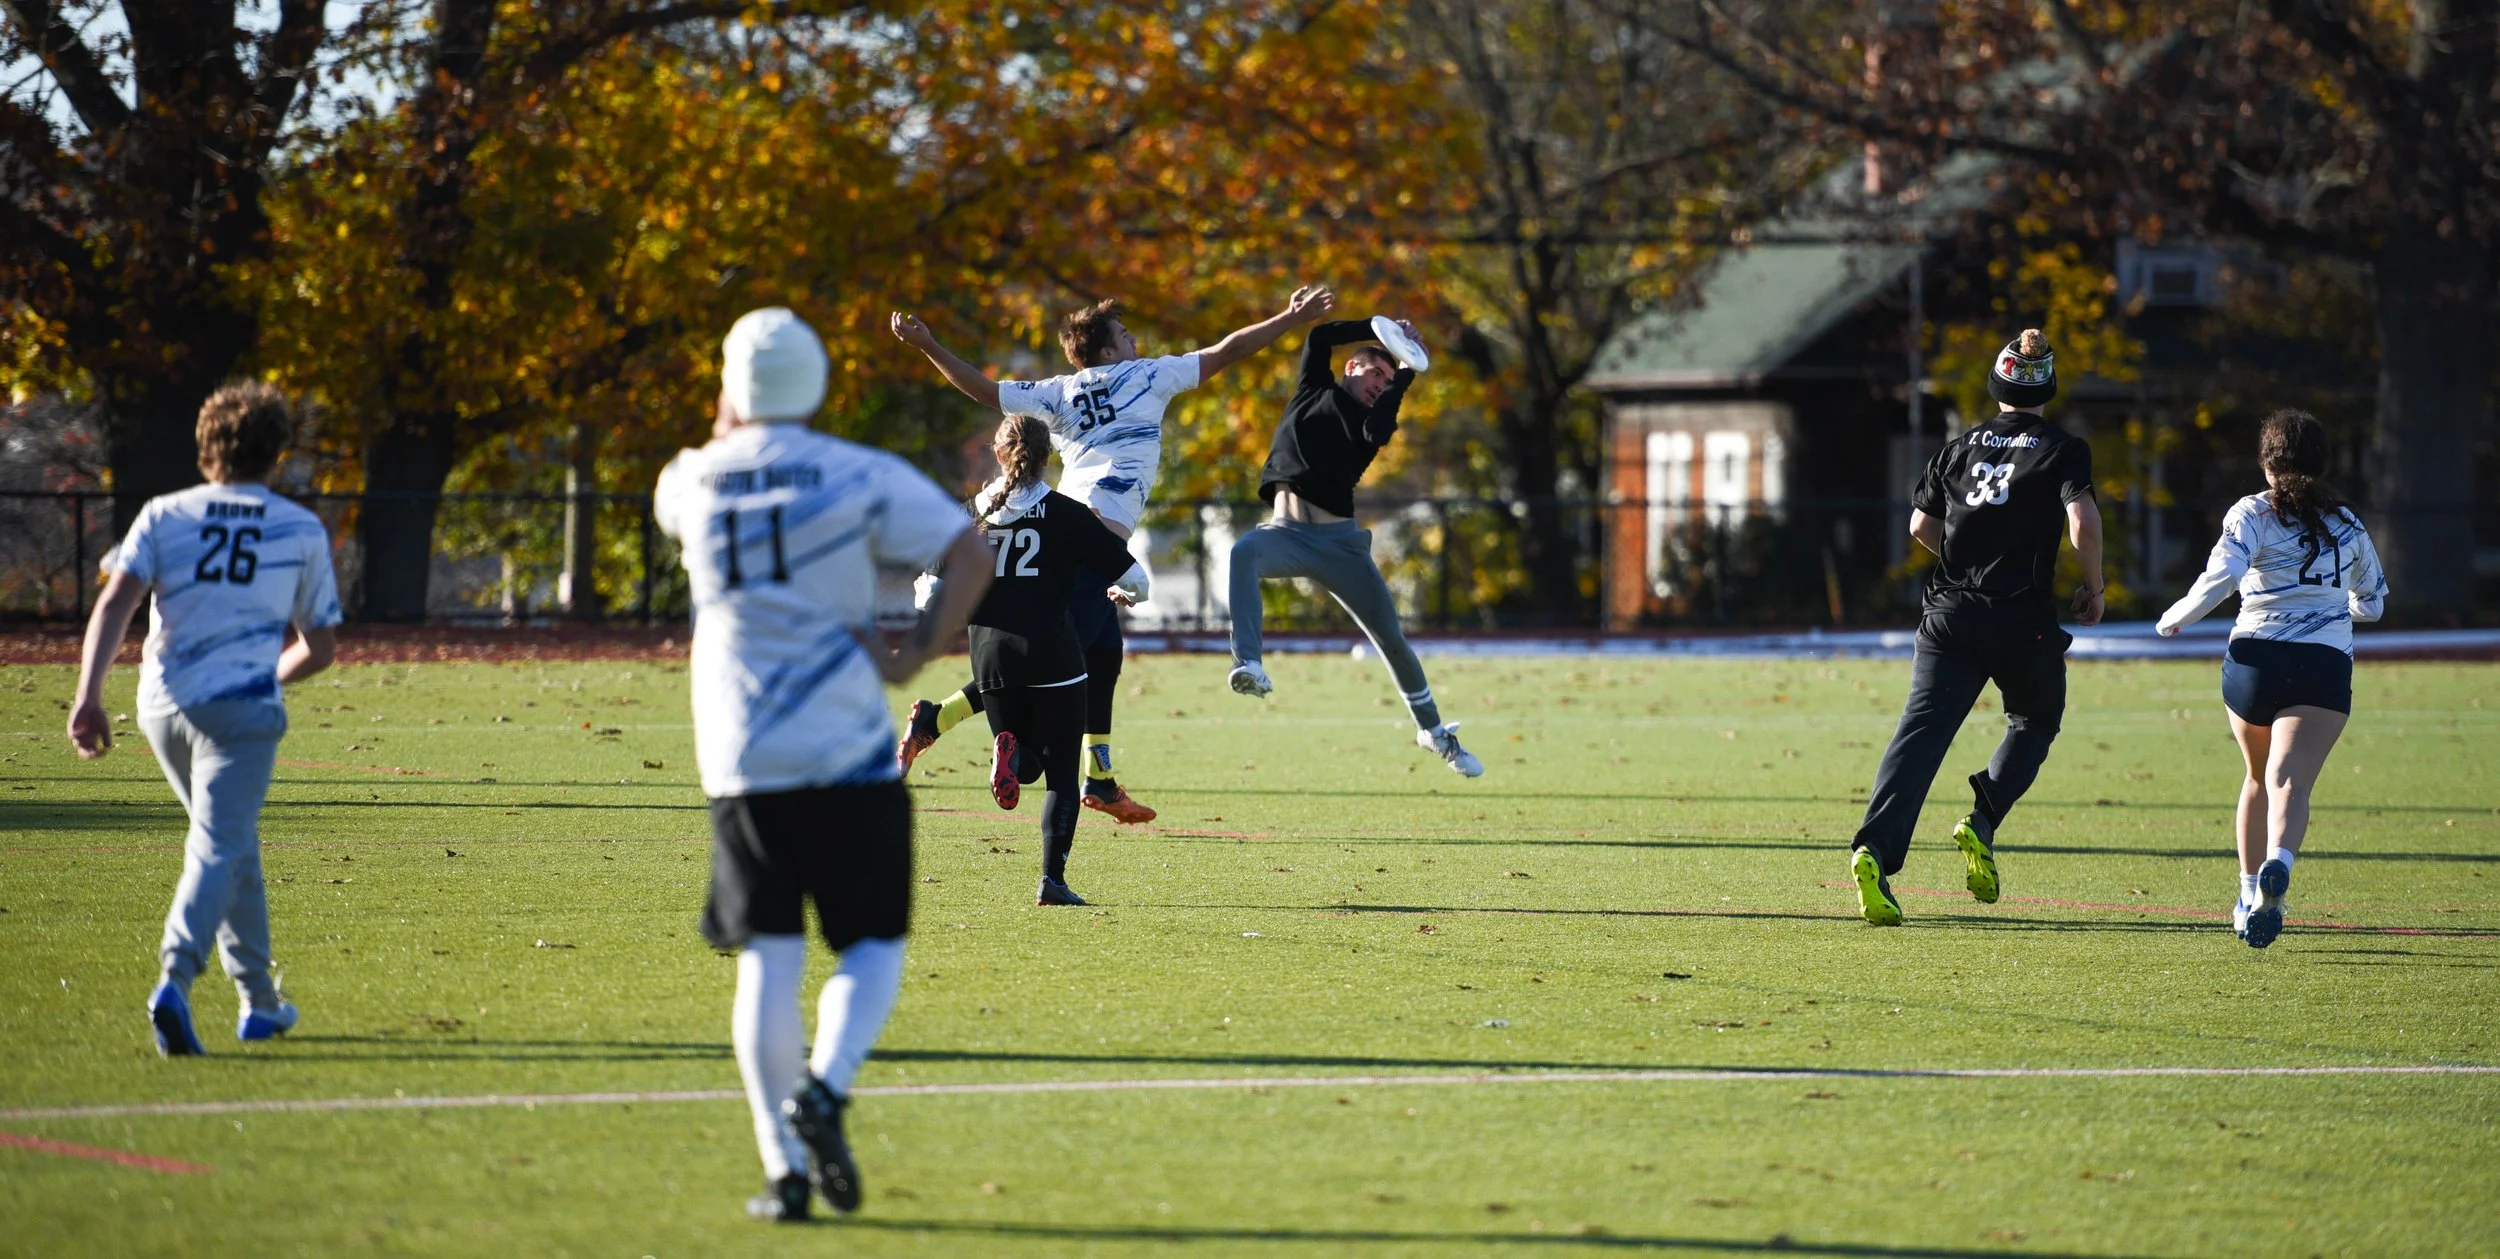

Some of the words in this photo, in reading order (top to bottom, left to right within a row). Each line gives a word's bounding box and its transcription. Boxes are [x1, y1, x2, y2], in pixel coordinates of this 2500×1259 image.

[1073, 387, 1116, 431] 35
[1981, 430, 2040, 449] Cornelius
[1965, 461, 2016, 507] 33
[194, 525, 262, 586] 26
[722, 506, 792, 592] 11
[987, 527, 1041, 578] 72
[2298, 534, 2342, 589] 21
